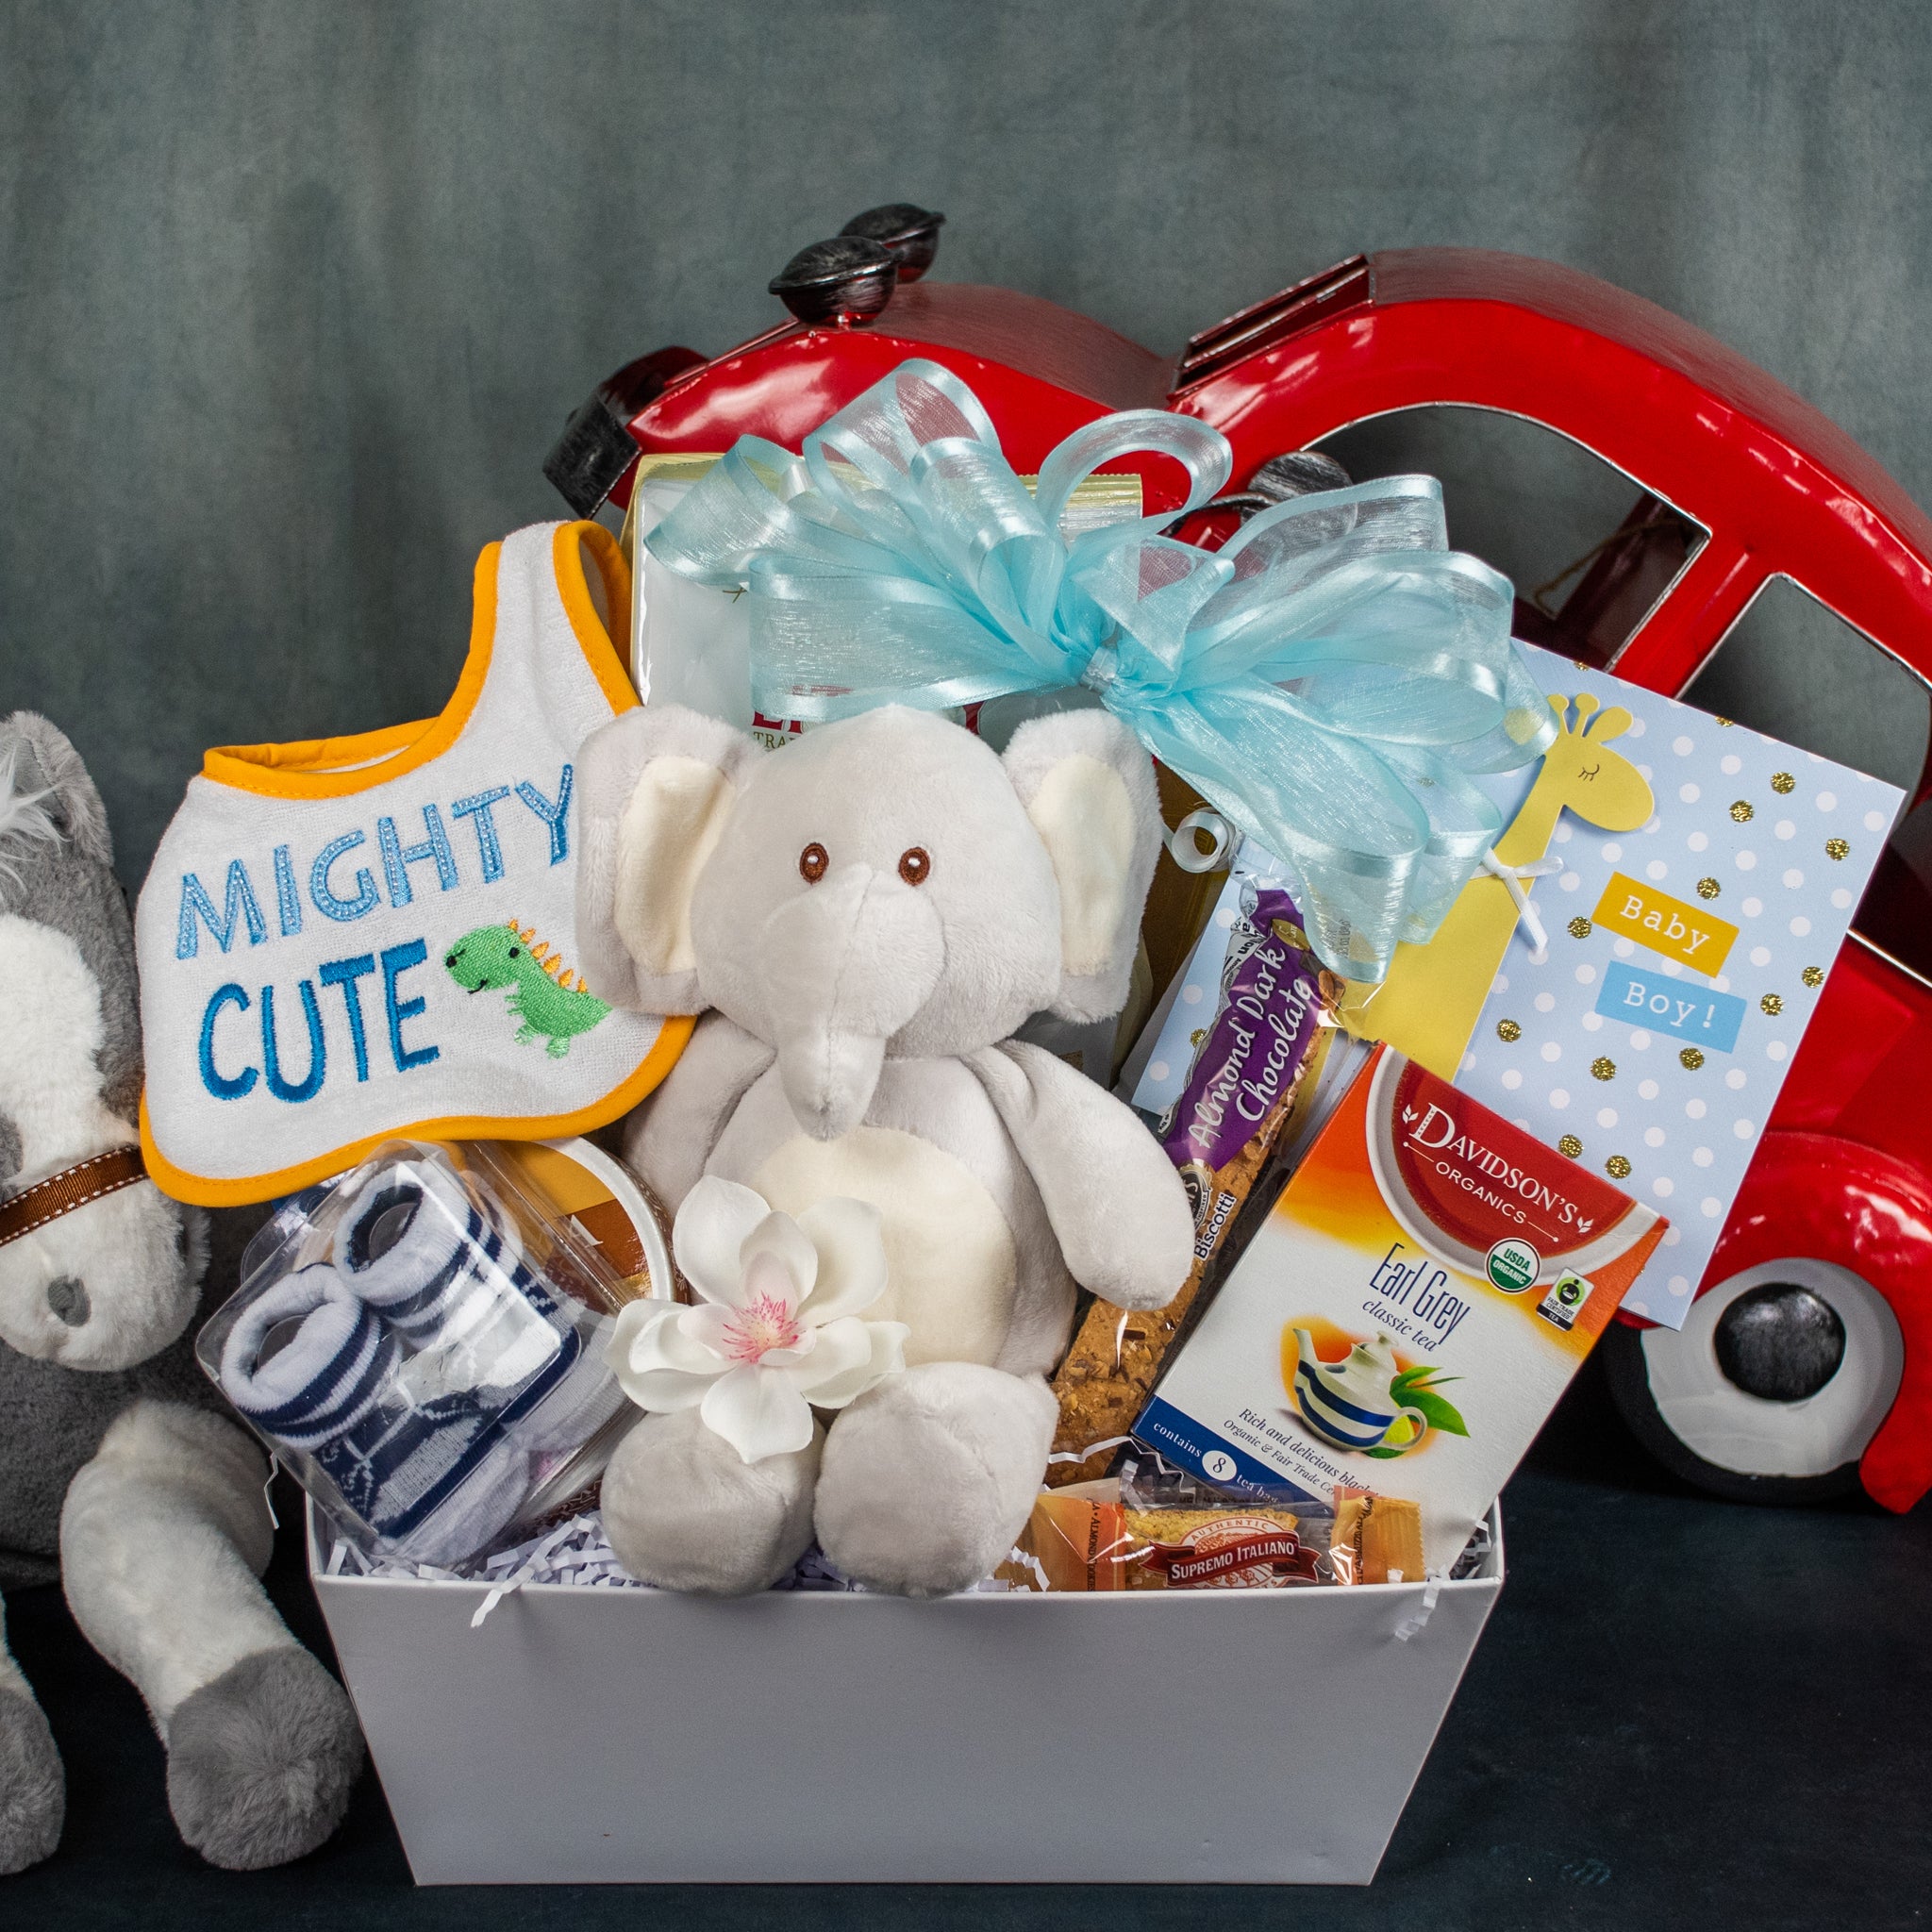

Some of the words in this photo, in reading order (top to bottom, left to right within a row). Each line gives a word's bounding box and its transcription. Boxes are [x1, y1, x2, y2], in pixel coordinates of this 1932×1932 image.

[176, 764, 573, 959] MIGHTY
[1620, 894, 1710, 955] Baby
[198, 939, 440, 1103] CUTE
[1624, 982, 1715, 1028] Boy!
[1188, 1020, 1256, 1149] Almond
[1236, 946, 1287, 1021] Dark
[1236, 977, 1313, 1122] Chocolate
[1408, 1102, 1579, 1224] DAVIDSON'S
[1436, 1161, 1527, 1224] ORGANICS
[1193, 1192, 1236, 1259] Biscotti
[1492, 1258, 1527, 1285] ORGANIC
[1504, 1248, 1531, 1272] USDA
[1369, 1241, 1428, 1305] Earl
[1412, 1270, 1471, 1345] Grey
[1546, 1302, 1571, 1320] CERTIFIED
[1547, 1297, 1559, 1307] FAIR
[1558, 1304, 1574, 1316] TRADE
[1548, 1312, 1559, 1323] TEA
[1362, 1301, 1412, 1335] classic
[1411, 1330, 1438, 1352] tea
[1153, 1423, 1202, 1457] contains
[1212, 1457, 1226, 1473] 8
[1237, 1474, 1255, 1491] tea
[1224, 1420, 1261, 1447] Organic
[1261, 1443, 1274, 1454] &
[1272, 1450, 1293, 1467] Fair
[1293, 1463, 1321, 1486] Trade
[1239, 1408, 1266, 1431] Rich
[1266, 1427, 1291, 1446] and
[1289, 1440, 1340, 1477] delicious
[1088, 1517, 1102, 1556] ALMOND
[1171, 1552, 1234, 1580] SUPREMO
[1237, 1541, 1295, 1562] ITALIANO
[1191, 1519, 1269, 1542] AUTHENTIC
